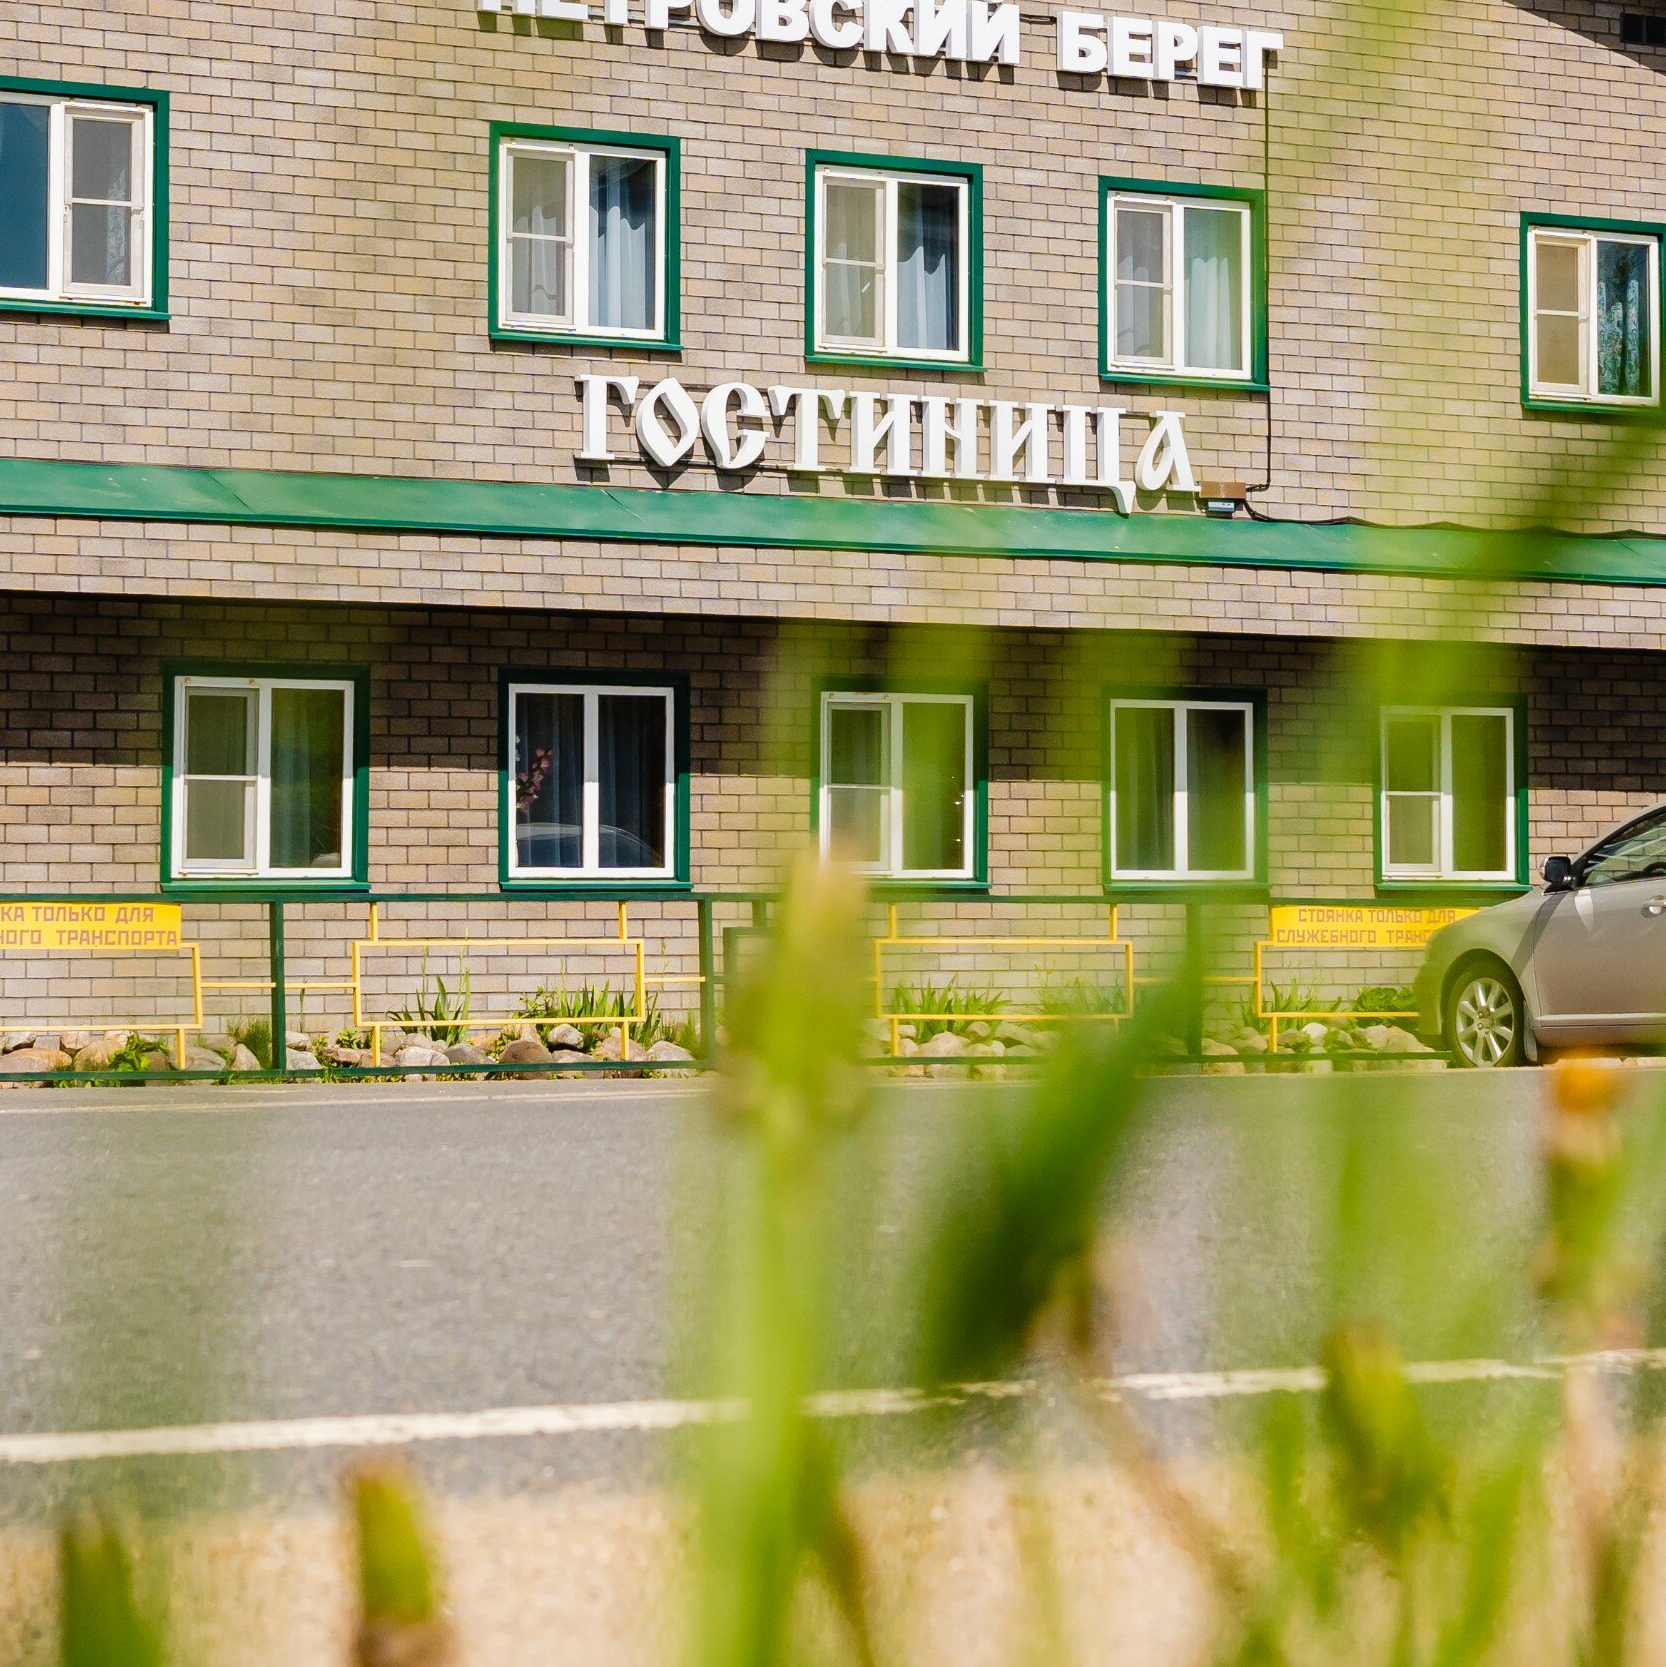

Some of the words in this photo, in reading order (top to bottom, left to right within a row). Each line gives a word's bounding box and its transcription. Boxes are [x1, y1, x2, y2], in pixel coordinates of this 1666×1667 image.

[1057, 10, 1284, 91] БЕРЕГ
[574, 373, 1202, 515] ГОСТИНИЦА
[32, 906, 106, 922] ТОЛЬКО
[115, 906, 154, 924] ДЛЯ
[1298, 908, 1363, 923] СТОЯНКА
[1368, 909, 1422, 924] ТОЛЬКО
[1427, 909, 1456, 924] ДЛЯ
[56, 929, 177, 946] ТРАНСПОРТА
[1276, 928, 1377, 944] СЛУЖЕБНОГО
[1386, 929, 1430, 944] ТРАНС
